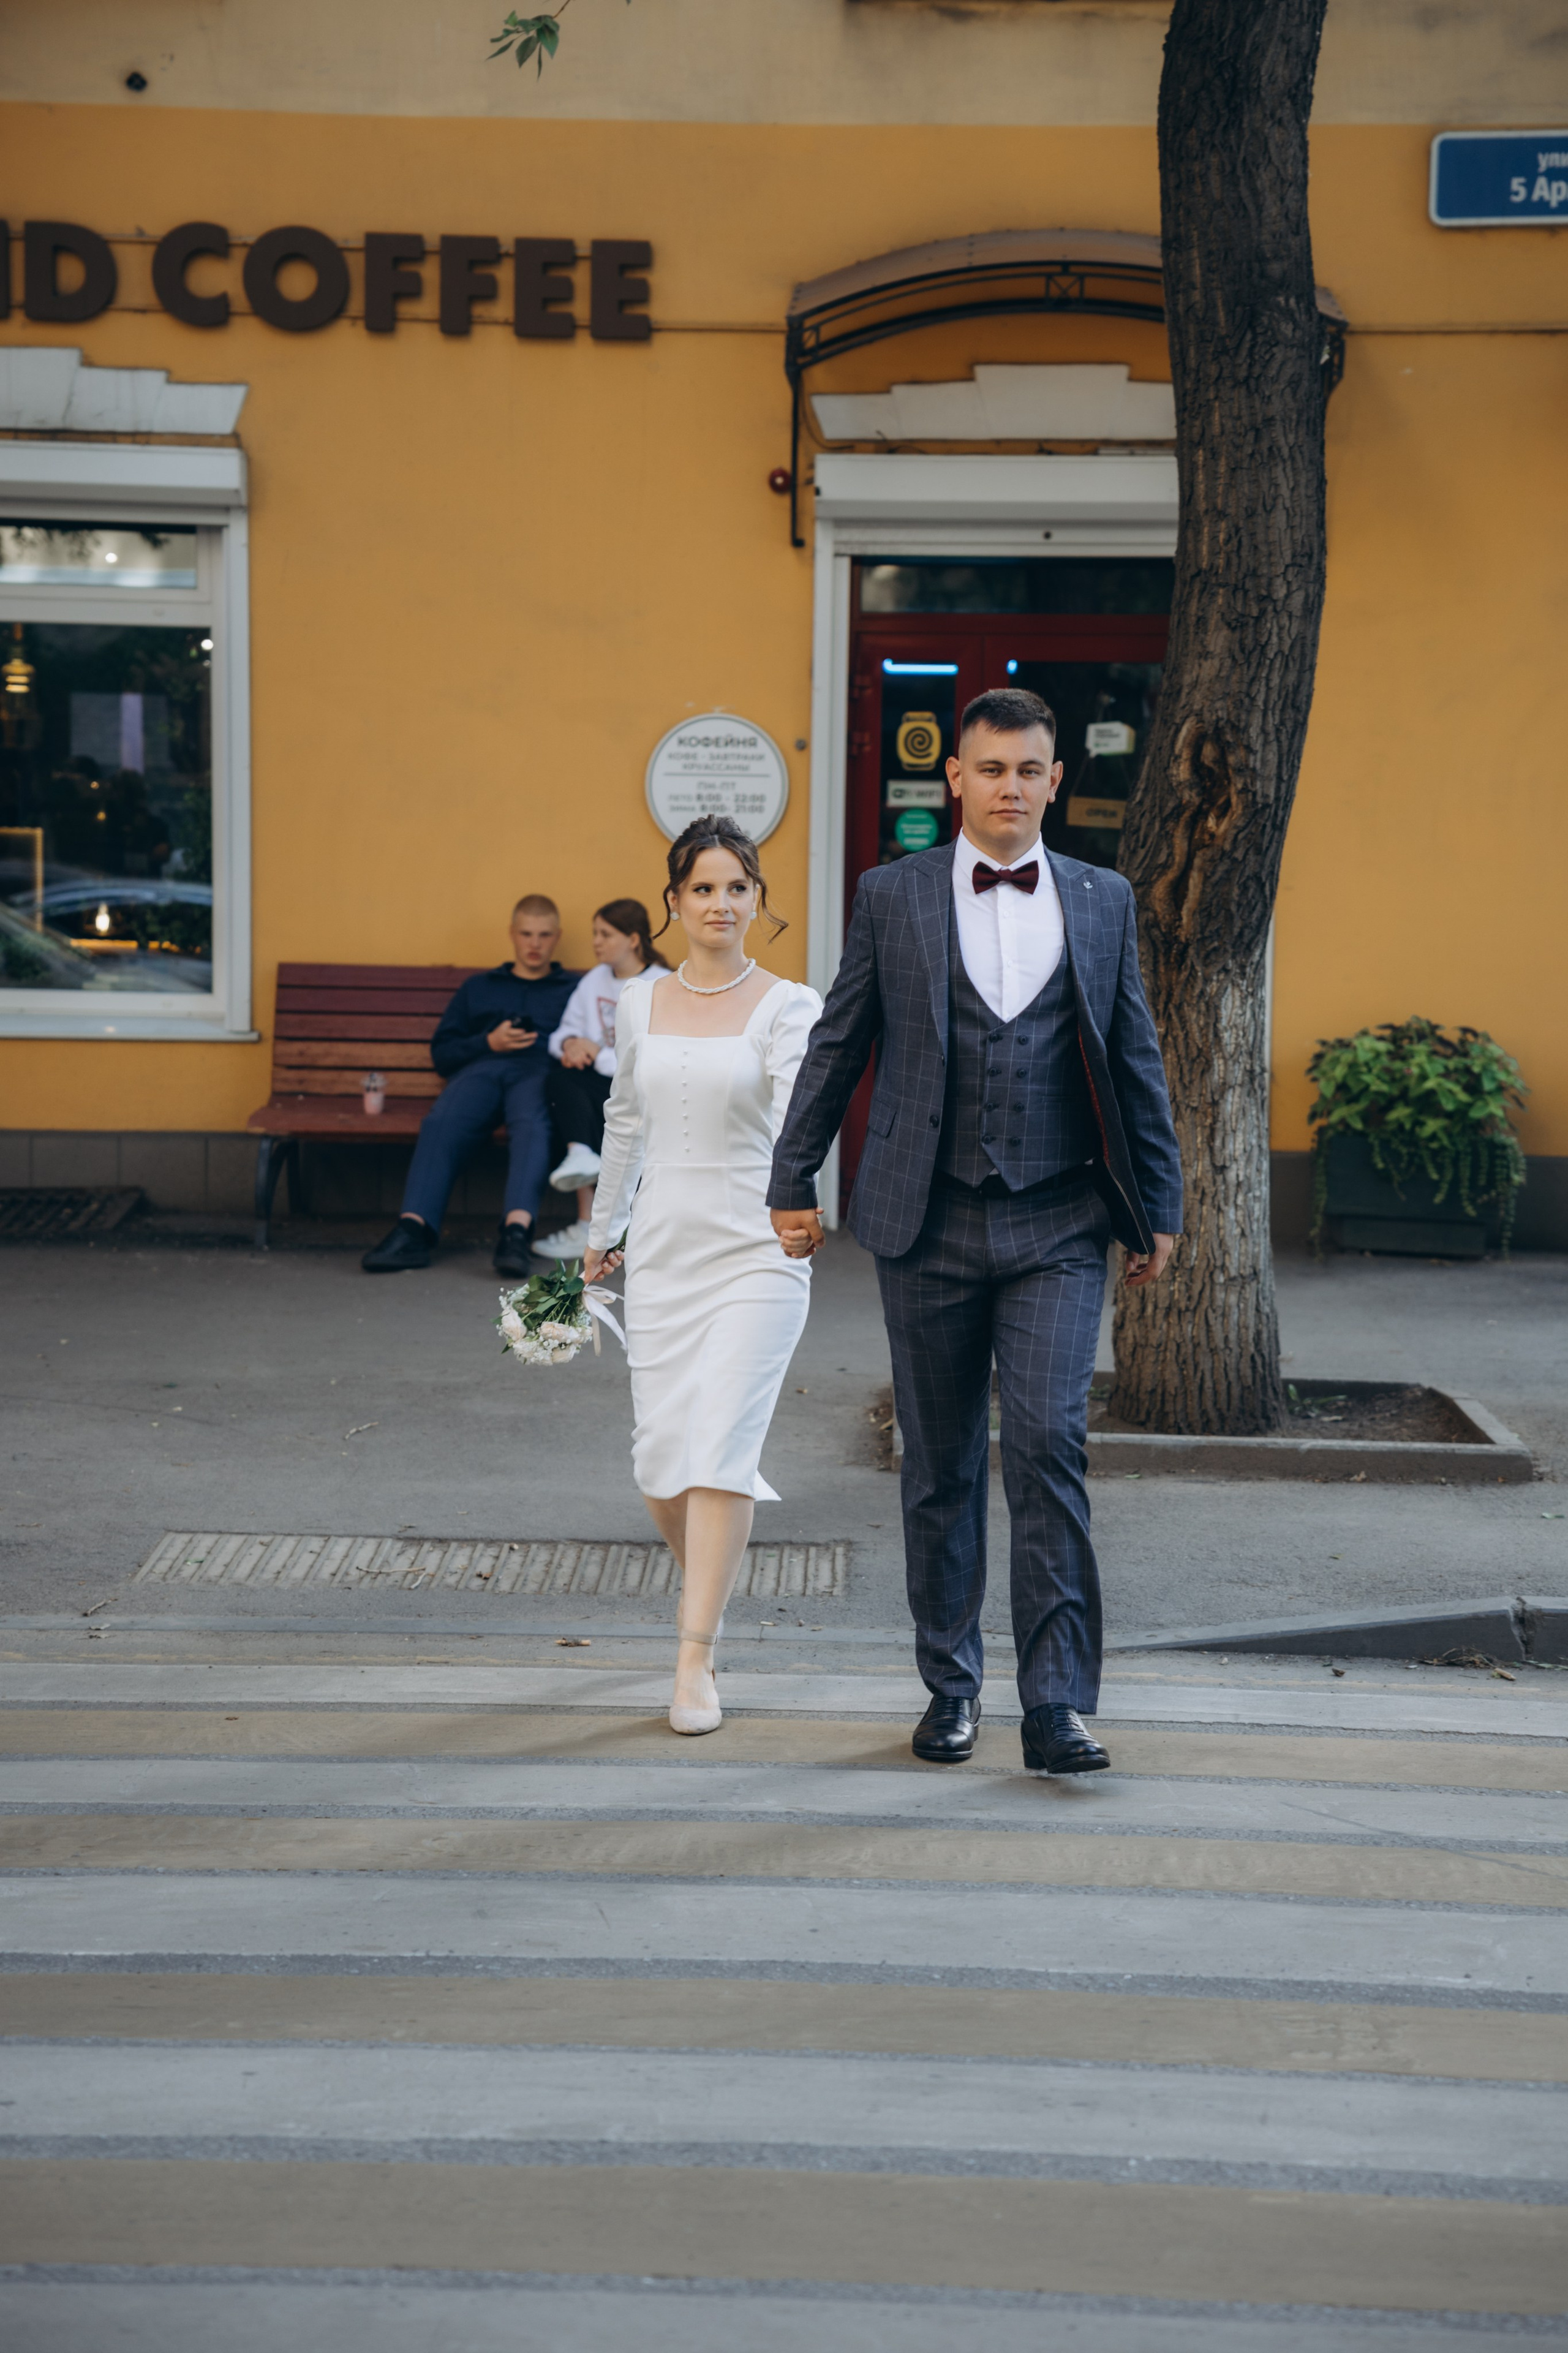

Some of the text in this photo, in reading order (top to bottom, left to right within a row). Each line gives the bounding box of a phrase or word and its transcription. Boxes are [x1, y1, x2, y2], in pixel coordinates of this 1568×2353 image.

[1510, 175, 1568, 208] 5 Ар
[0, 219, 652, 341] D COFFEE
[677, 735, 757, 747] КОФЕЙНЯ
